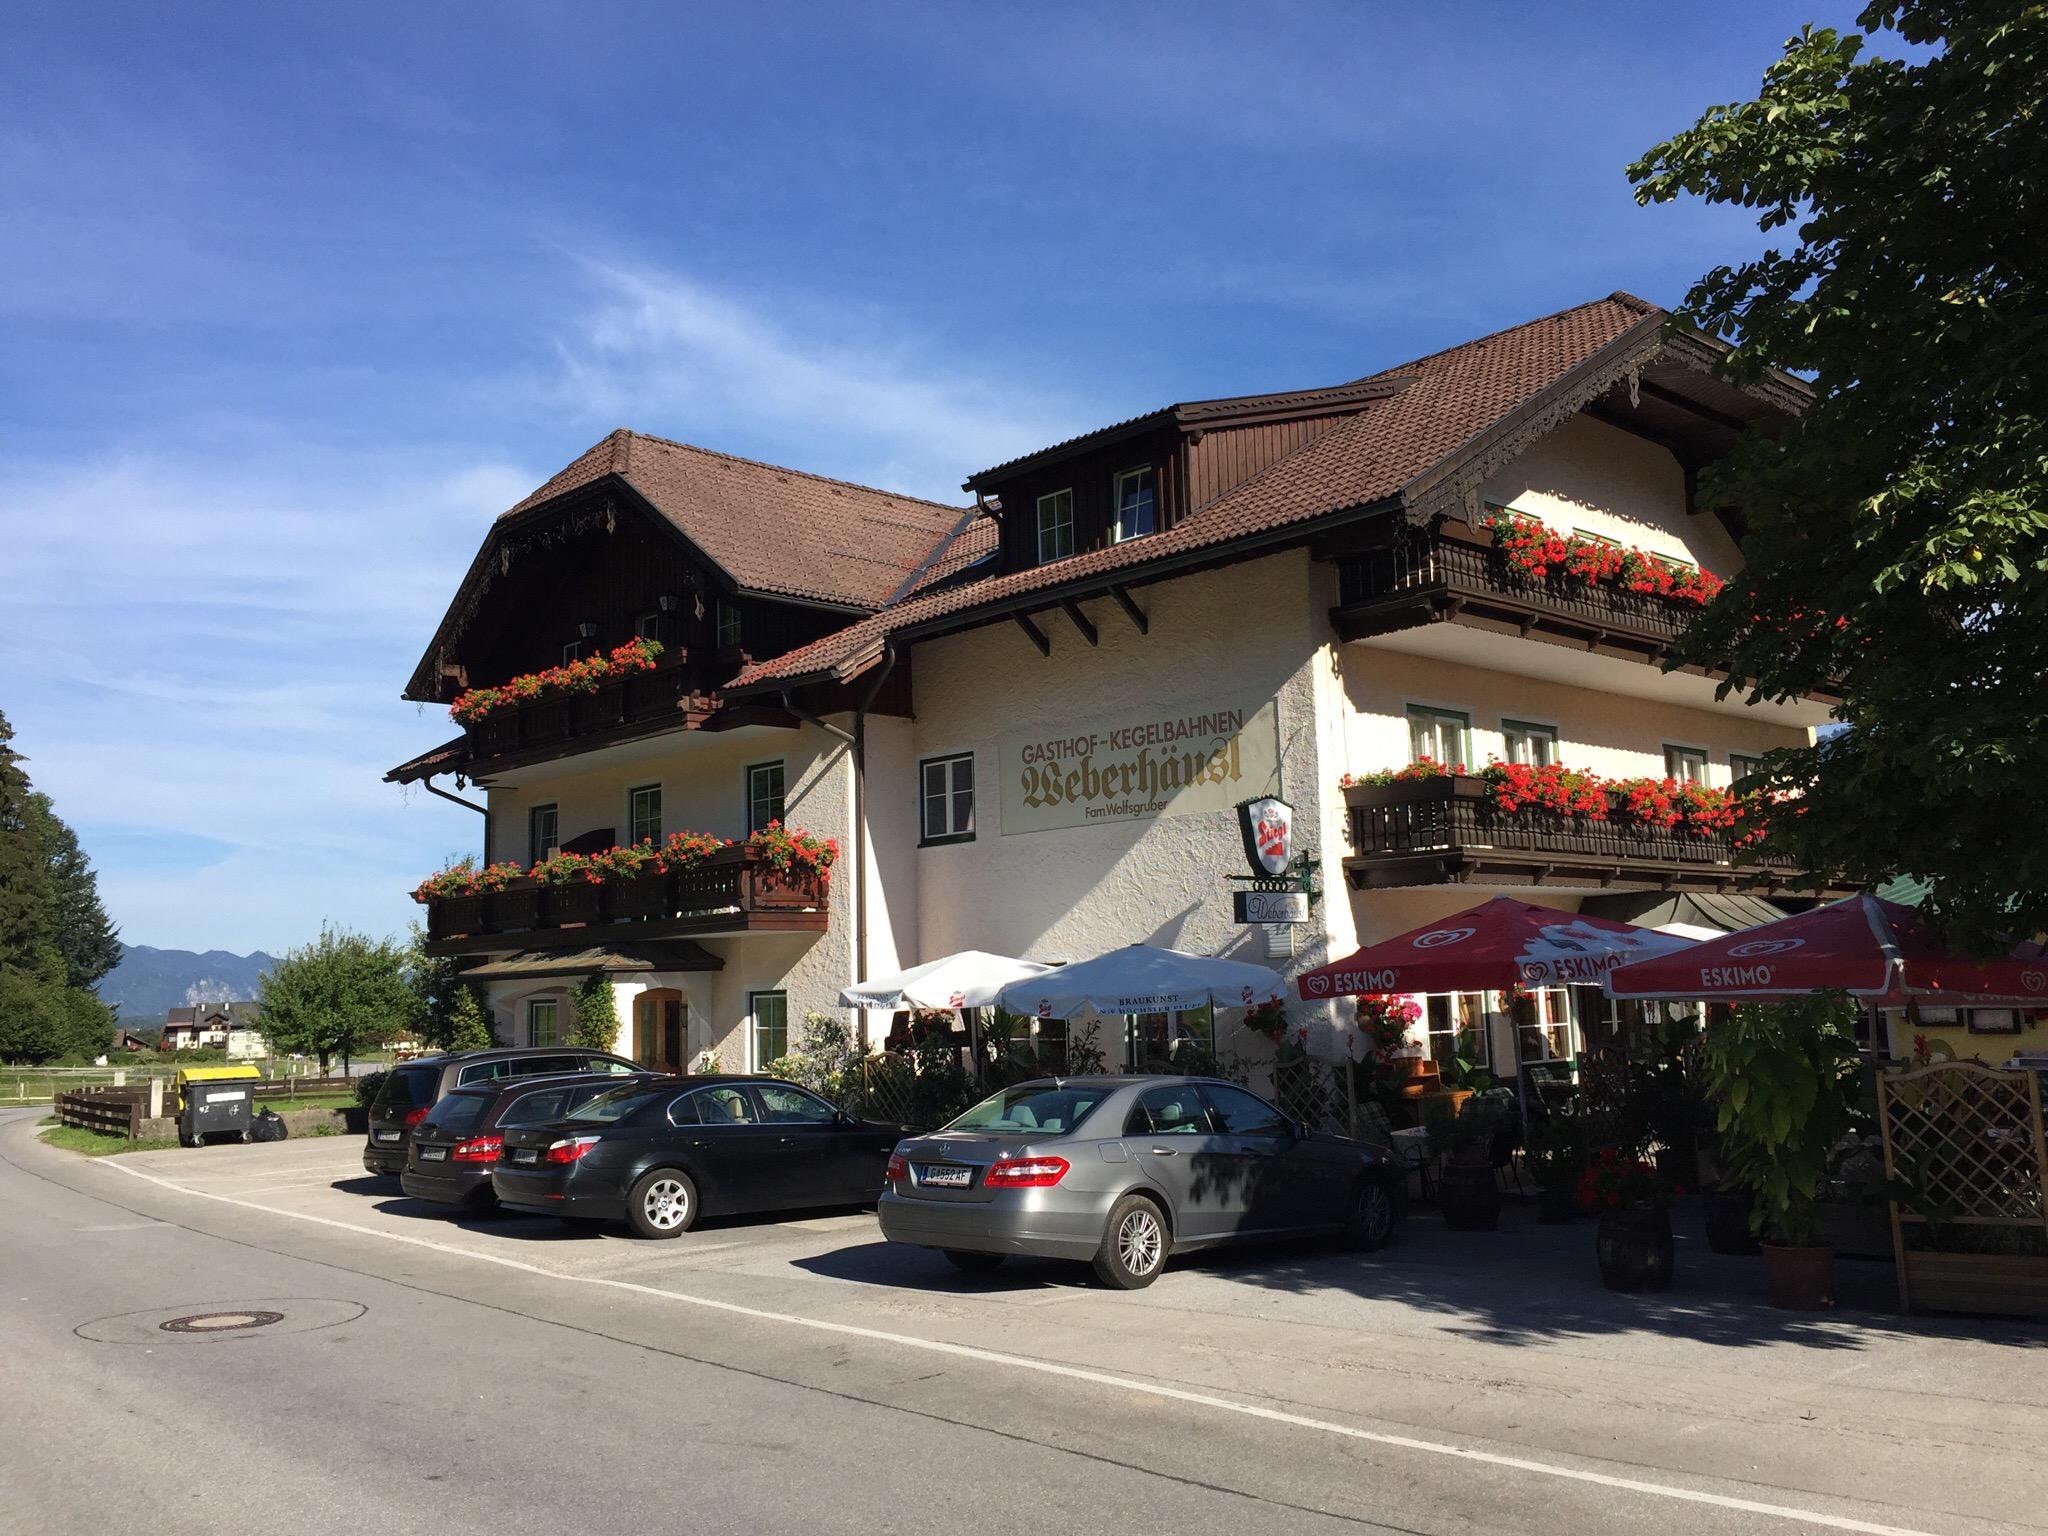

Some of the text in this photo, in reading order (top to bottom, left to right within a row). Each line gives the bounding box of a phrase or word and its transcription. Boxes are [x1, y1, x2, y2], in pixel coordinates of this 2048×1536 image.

[1258, 820, 1287, 847] Stiegl
[1334, 969, 1395, 992] ESKIMO
[1700, 965, 1771, 986] ESKIMO
[1118, 994, 1179, 1006] BRAUKUNST
